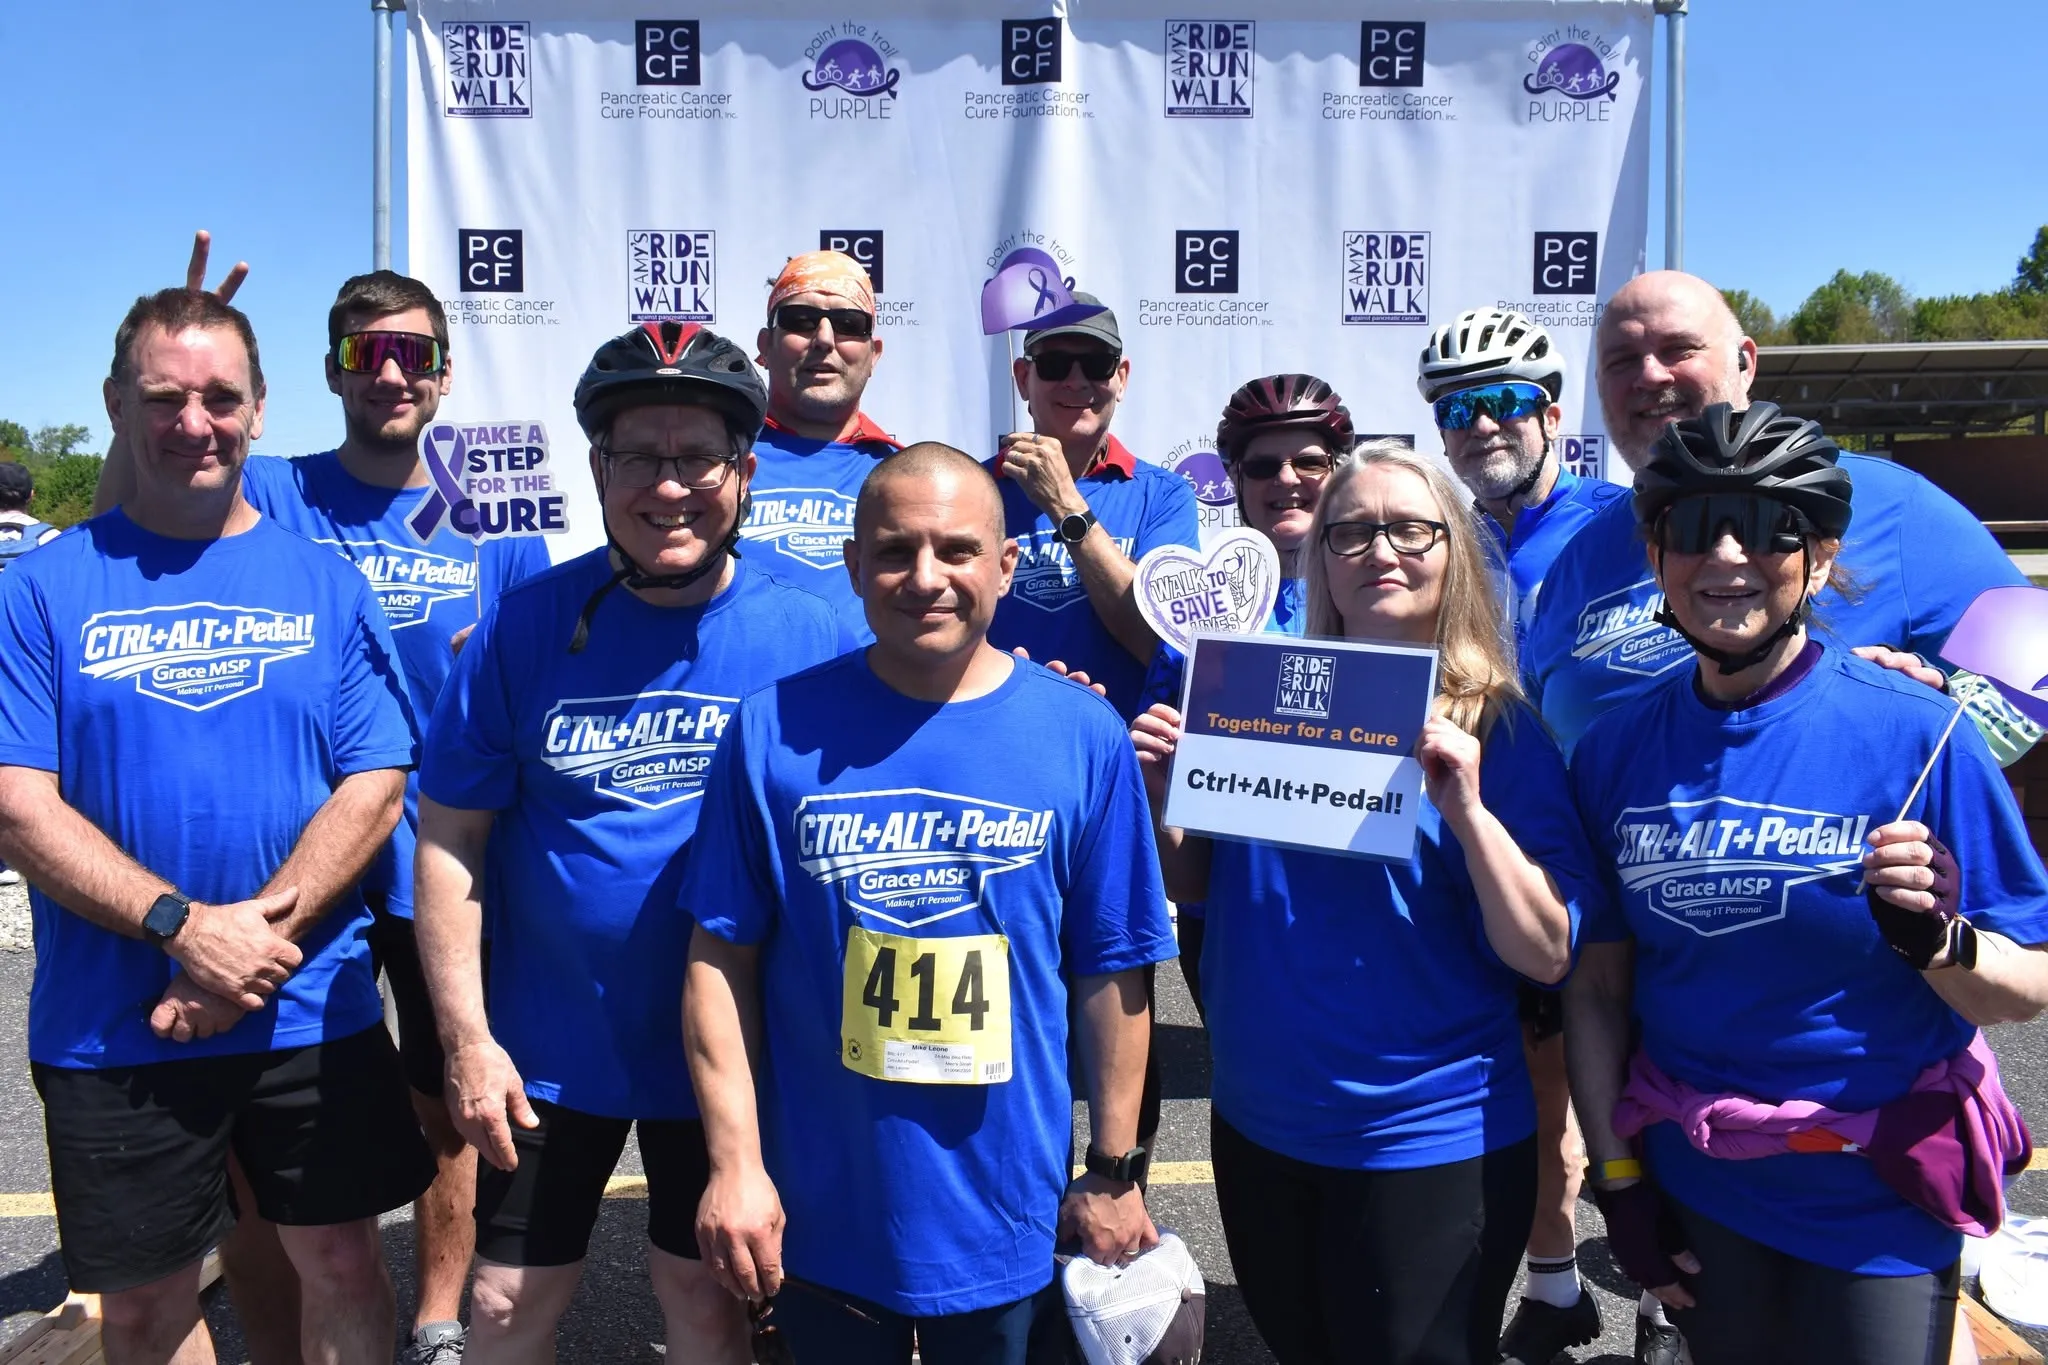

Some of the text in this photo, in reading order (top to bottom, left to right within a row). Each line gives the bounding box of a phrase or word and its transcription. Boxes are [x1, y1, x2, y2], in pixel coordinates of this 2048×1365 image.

[465, 25, 525, 50] RIDE
[804, 20, 899, 60] paint the trail
[1188, 23, 1249, 50] RIDE
[1527, 24, 1621, 64] paint the trail
[449, 25, 464, 78] AMY'S
[1168, 23, 1187, 77] AMY'S
[467, 53, 525, 78] RUN
[1189, 52, 1248, 78] RUN
[452, 80, 525, 106] WALK
[601, 92, 732, 105] Pancreatic Cancer
[965, 89, 1090, 105] Pancreatic Cancer
[1172, 79, 1247, 106] WALK
[1323, 92, 1453, 107] Pancreatic Cancer
[601, 106, 634, 119] Cure
[810, 98, 891, 119] PURPLE
[965, 106, 999, 119] Cure
[1322, 107, 1355, 120] Cure
[1529, 101, 1610, 122] PURPLE
[650, 233, 710, 258] RIDE
[986, 228, 1075, 269] paint the trail
[1366, 235, 1424, 259] RIDE
[631, 233, 649, 285] AMY'S
[1347, 234, 1364, 286] AMY'S
[651, 261, 710, 285] RUN
[1366, 262, 1424, 286] RUN
[443, 298, 555, 311] ncreatic Cancer
[635, 287, 710, 312] WALK
[875, 301, 914, 311] ancer
[1140, 299, 1269, 312] Pancreatic Cancer
[1349, 288, 1423, 313] WALK
[1497, 300, 1606, 313] Pancreatic Can
[1139, 313, 1172, 326] Cure
[1535, 314, 1600, 326] Foundati
[462, 425, 544, 446] TAKE A
[467, 447, 545, 473] STEP
[1560, 438, 1598, 462] IDE
[466, 475, 551, 494] FOR THE
[450, 496, 565, 534] CURE
[1198, 508, 1240, 528] RPLE
[788, 533, 827, 545] Grace
[1026, 579, 1060, 590] Grace
[1150, 568, 1227, 602] WALK TO
[388, 594, 422, 606] MSP
[1170, 590, 1228, 625] SAVE
[84, 614, 315, 661] CTRL+ALT+Pedal!
[1622, 631, 1666, 654] Grace
[152, 659, 251, 682] Grace MSP
[1281, 656, 1294, 690] AMY'S
[1294, 656, 1332, 675] RIDE
[177, 680, 244, 696] Making IT Personal
[1292, 674, 1330, 693] RUN
[1281, 690, 1327, 710] WALK
[546, 705, 731, 753] CTRL+ALT+Pe
[1207, 713, 1399, 747] Together for a Cure
[612, 757, 711, 780] Grace MSP
[635, 780, 702, 793] Making IT Personal
[1187, 768, 1403, 815] Ctrl+Alt+Pedal!
[801, 810, 1054, 856] CTRL+ALT+Pedal!
[860, 868, 972, 890] Grace MSP
[1661, 877, 1772, 898] Grace MSP
[886, 894, 962, 908] Making IT Personal
[1685, 904, 1762, 917] Making IT Personal
[863, 946, 989, 1031] 414
